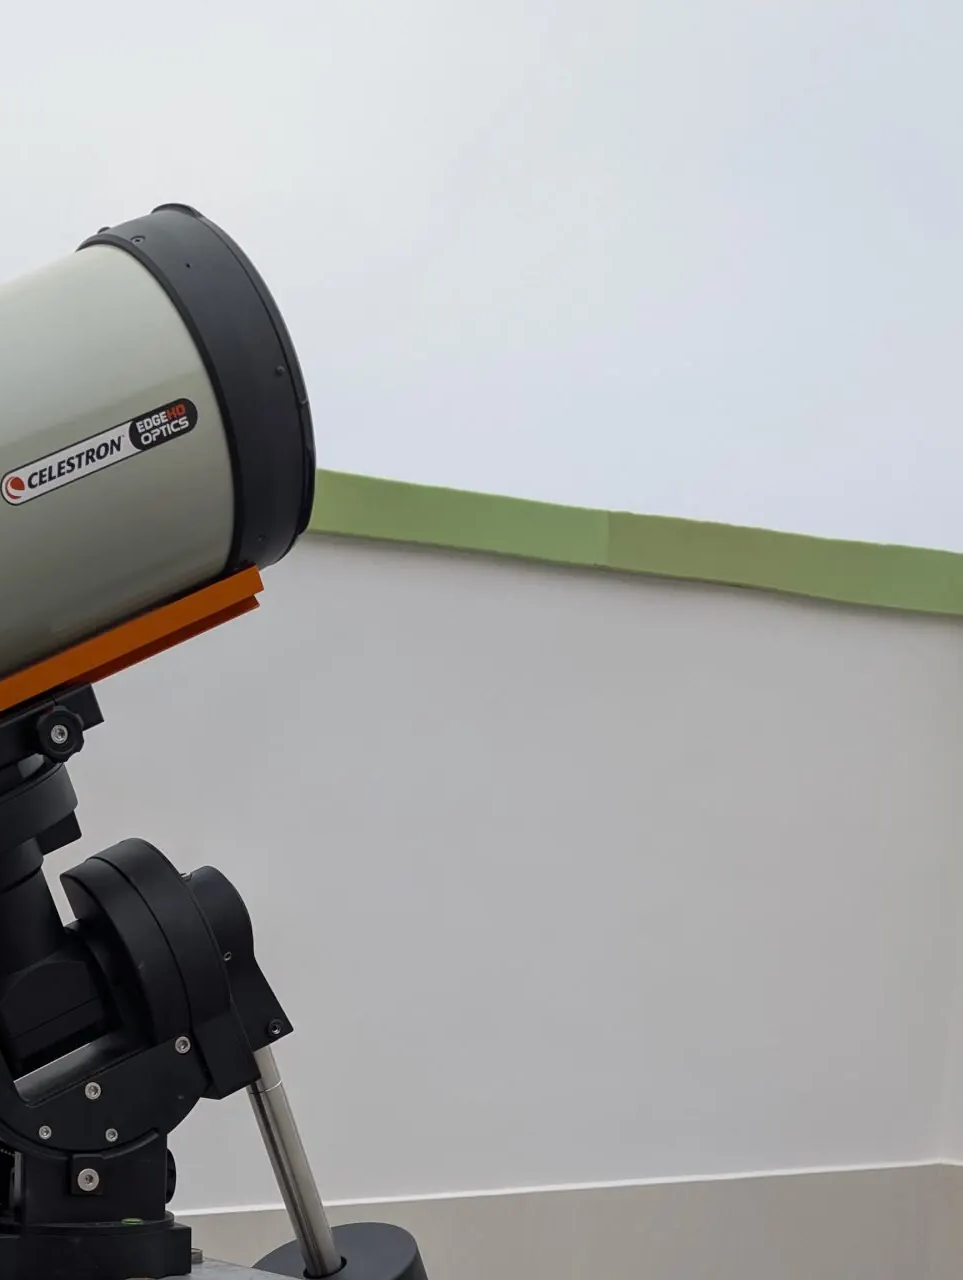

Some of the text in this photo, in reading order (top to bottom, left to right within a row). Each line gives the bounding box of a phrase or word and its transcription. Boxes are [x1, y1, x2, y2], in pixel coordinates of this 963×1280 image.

[136, 403, 185, 434] EDGEHD
[140, 416, 189, 445] OPTICS
[27, 436, 122, 489] CELESTRON
